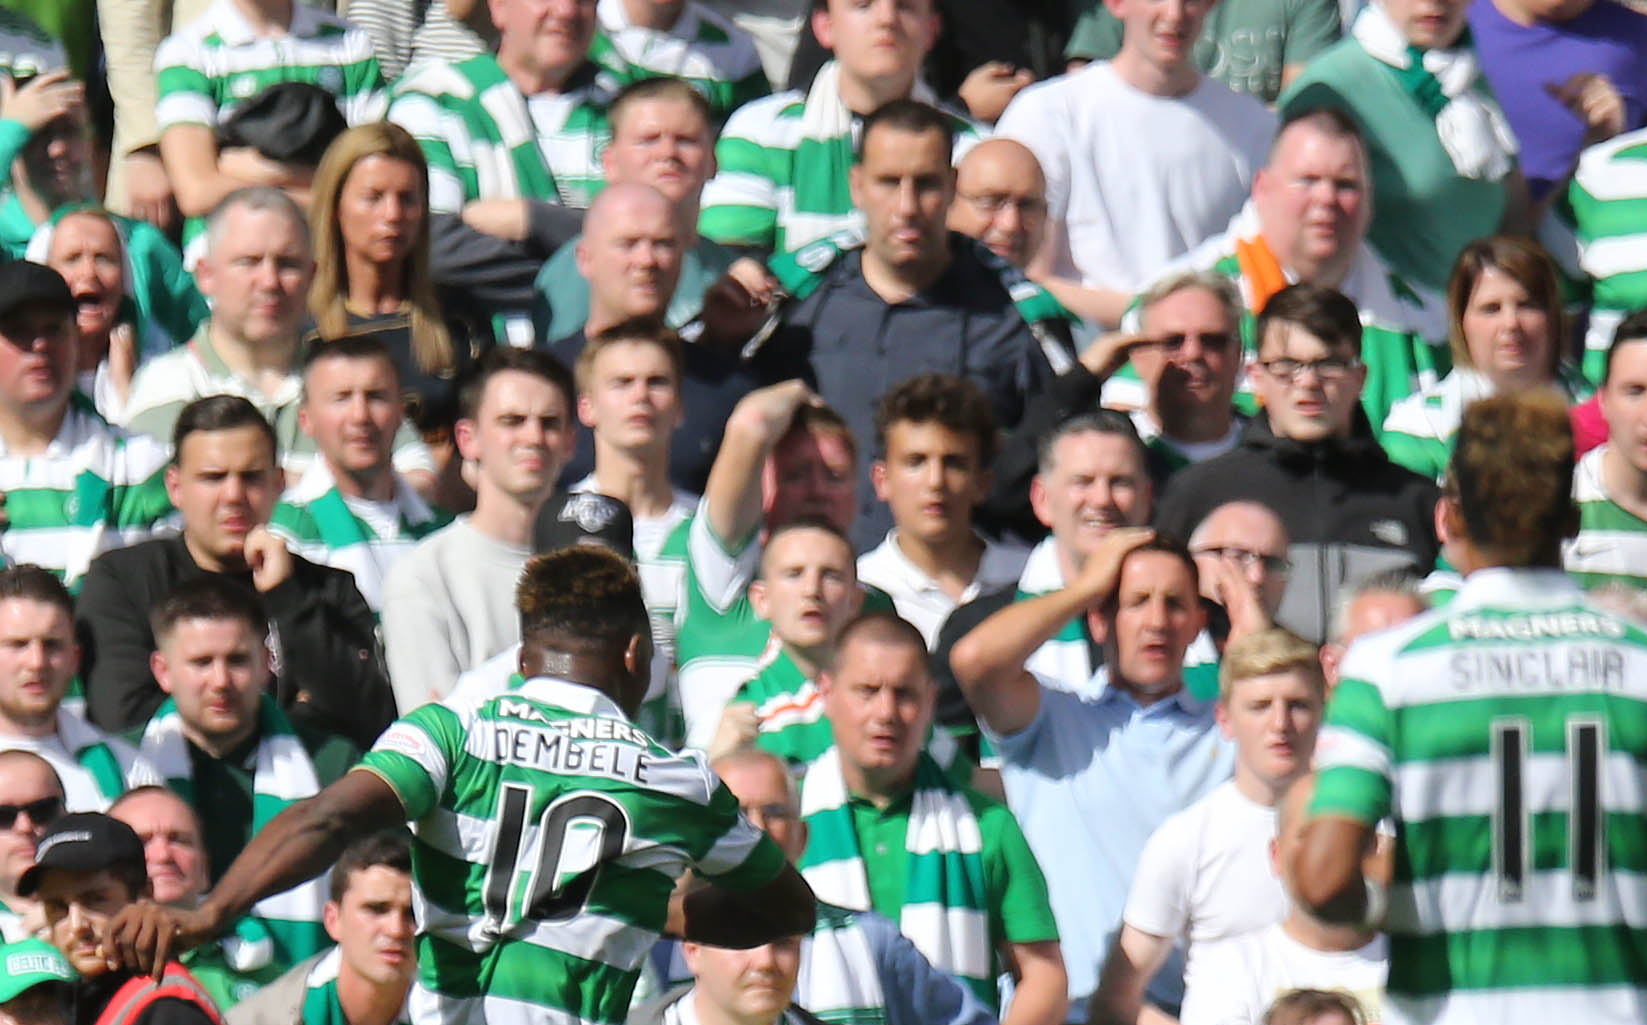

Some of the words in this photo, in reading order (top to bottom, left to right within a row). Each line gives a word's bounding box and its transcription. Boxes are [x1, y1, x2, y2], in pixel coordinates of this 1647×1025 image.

[1450, 613, 1627, 640] MAGNERS
[1450, 645, 1627, 690] SINCLAIR
[495, 728, 650, 784] DEMBELE
[1490, 713, 1610, 903] 11
[481, 780, 633, 937] 10
